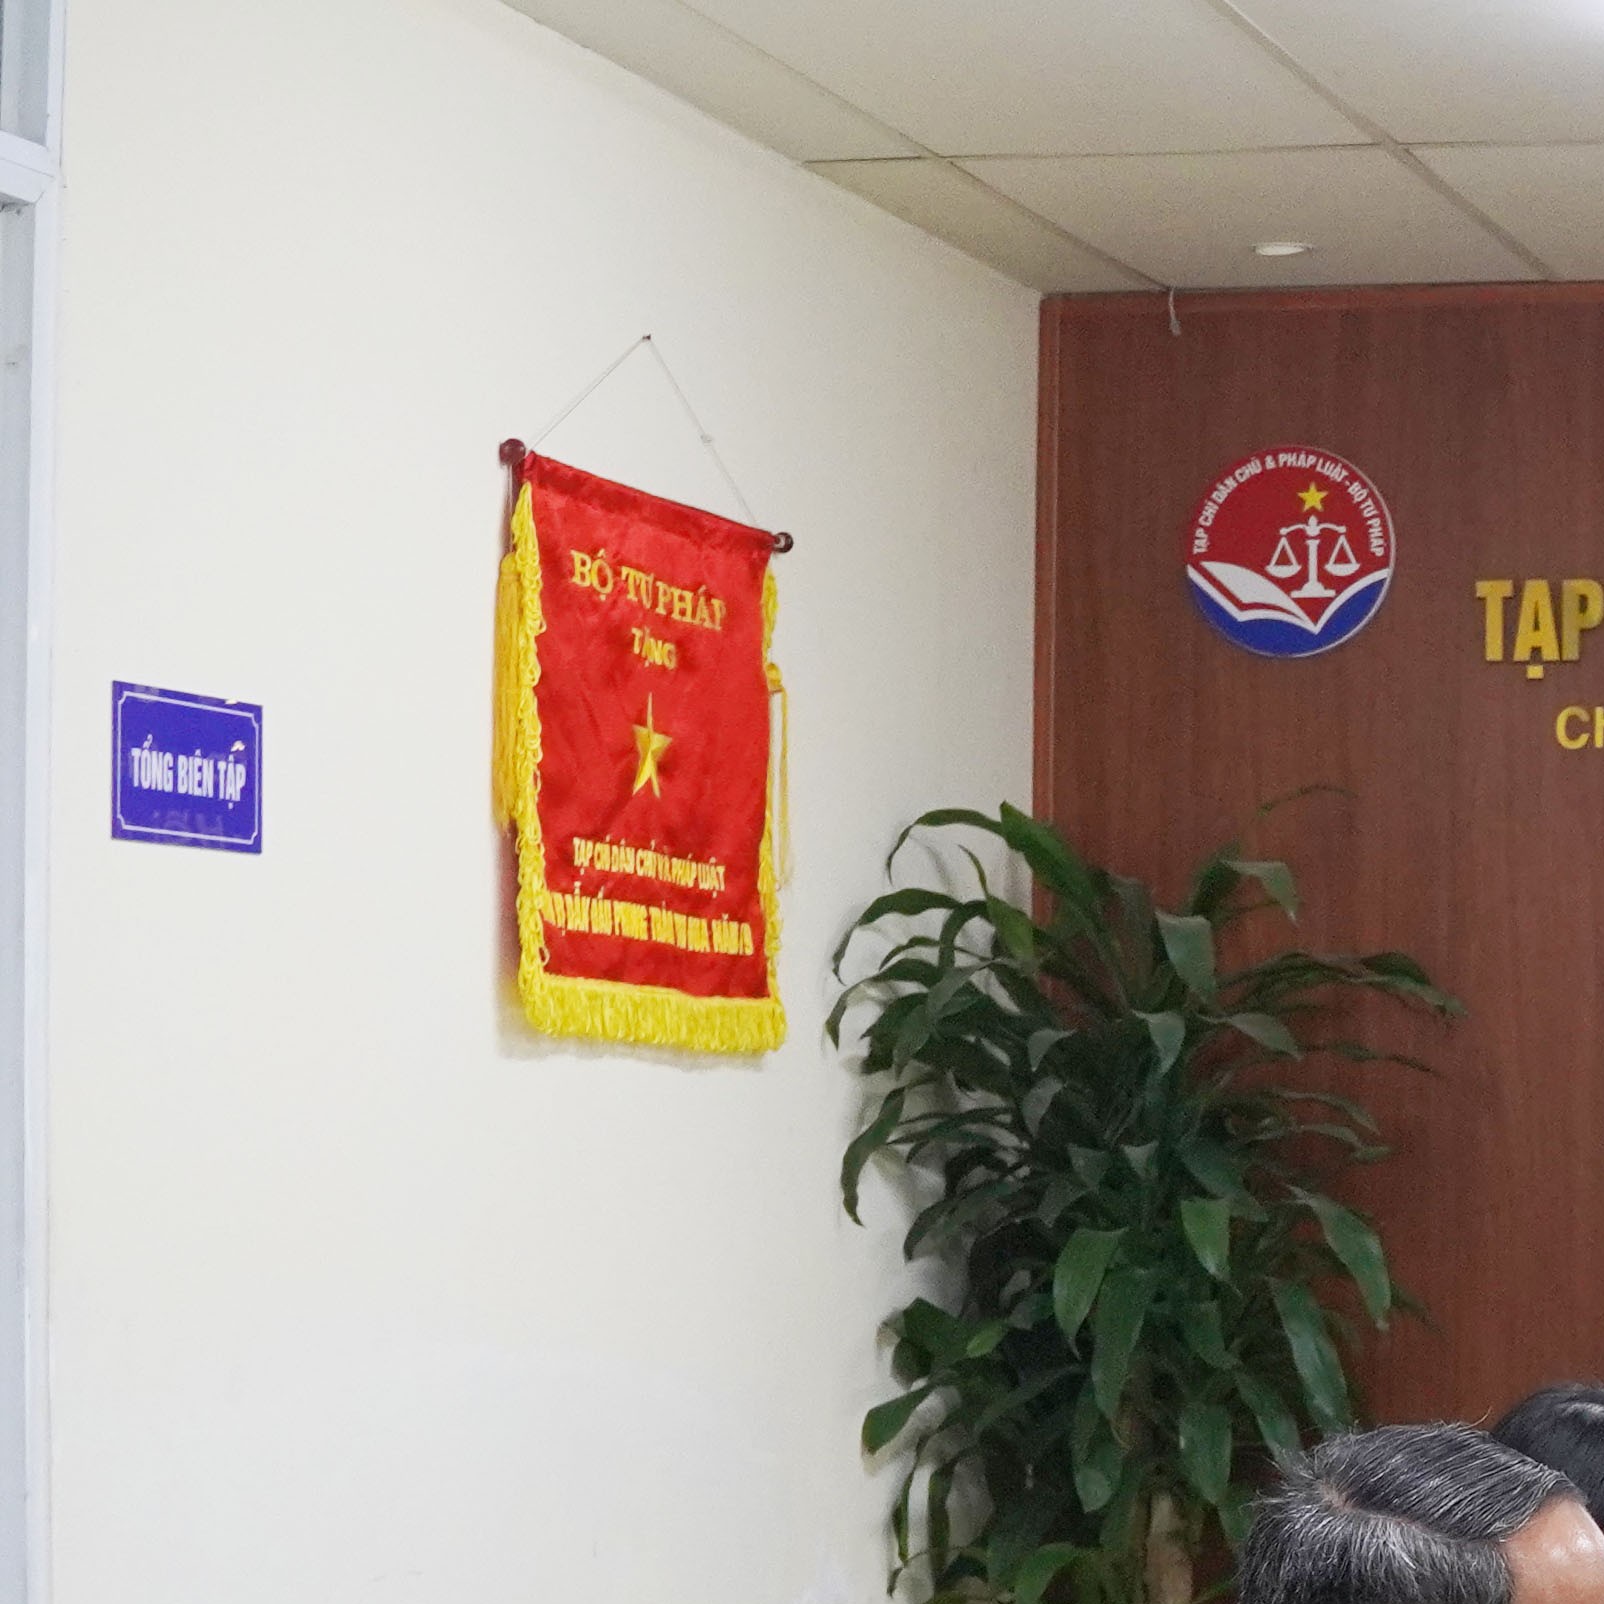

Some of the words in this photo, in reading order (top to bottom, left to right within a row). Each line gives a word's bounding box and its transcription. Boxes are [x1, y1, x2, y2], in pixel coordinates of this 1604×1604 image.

[1278, 450, 1317, 469] PHÁP
[570, 548, 614, 602] BỘ
[655, 584, 727, 631] PHÁP
[130, 733, 174, 793] TỔNG
[177, 748, 214, 798] BIÊN
